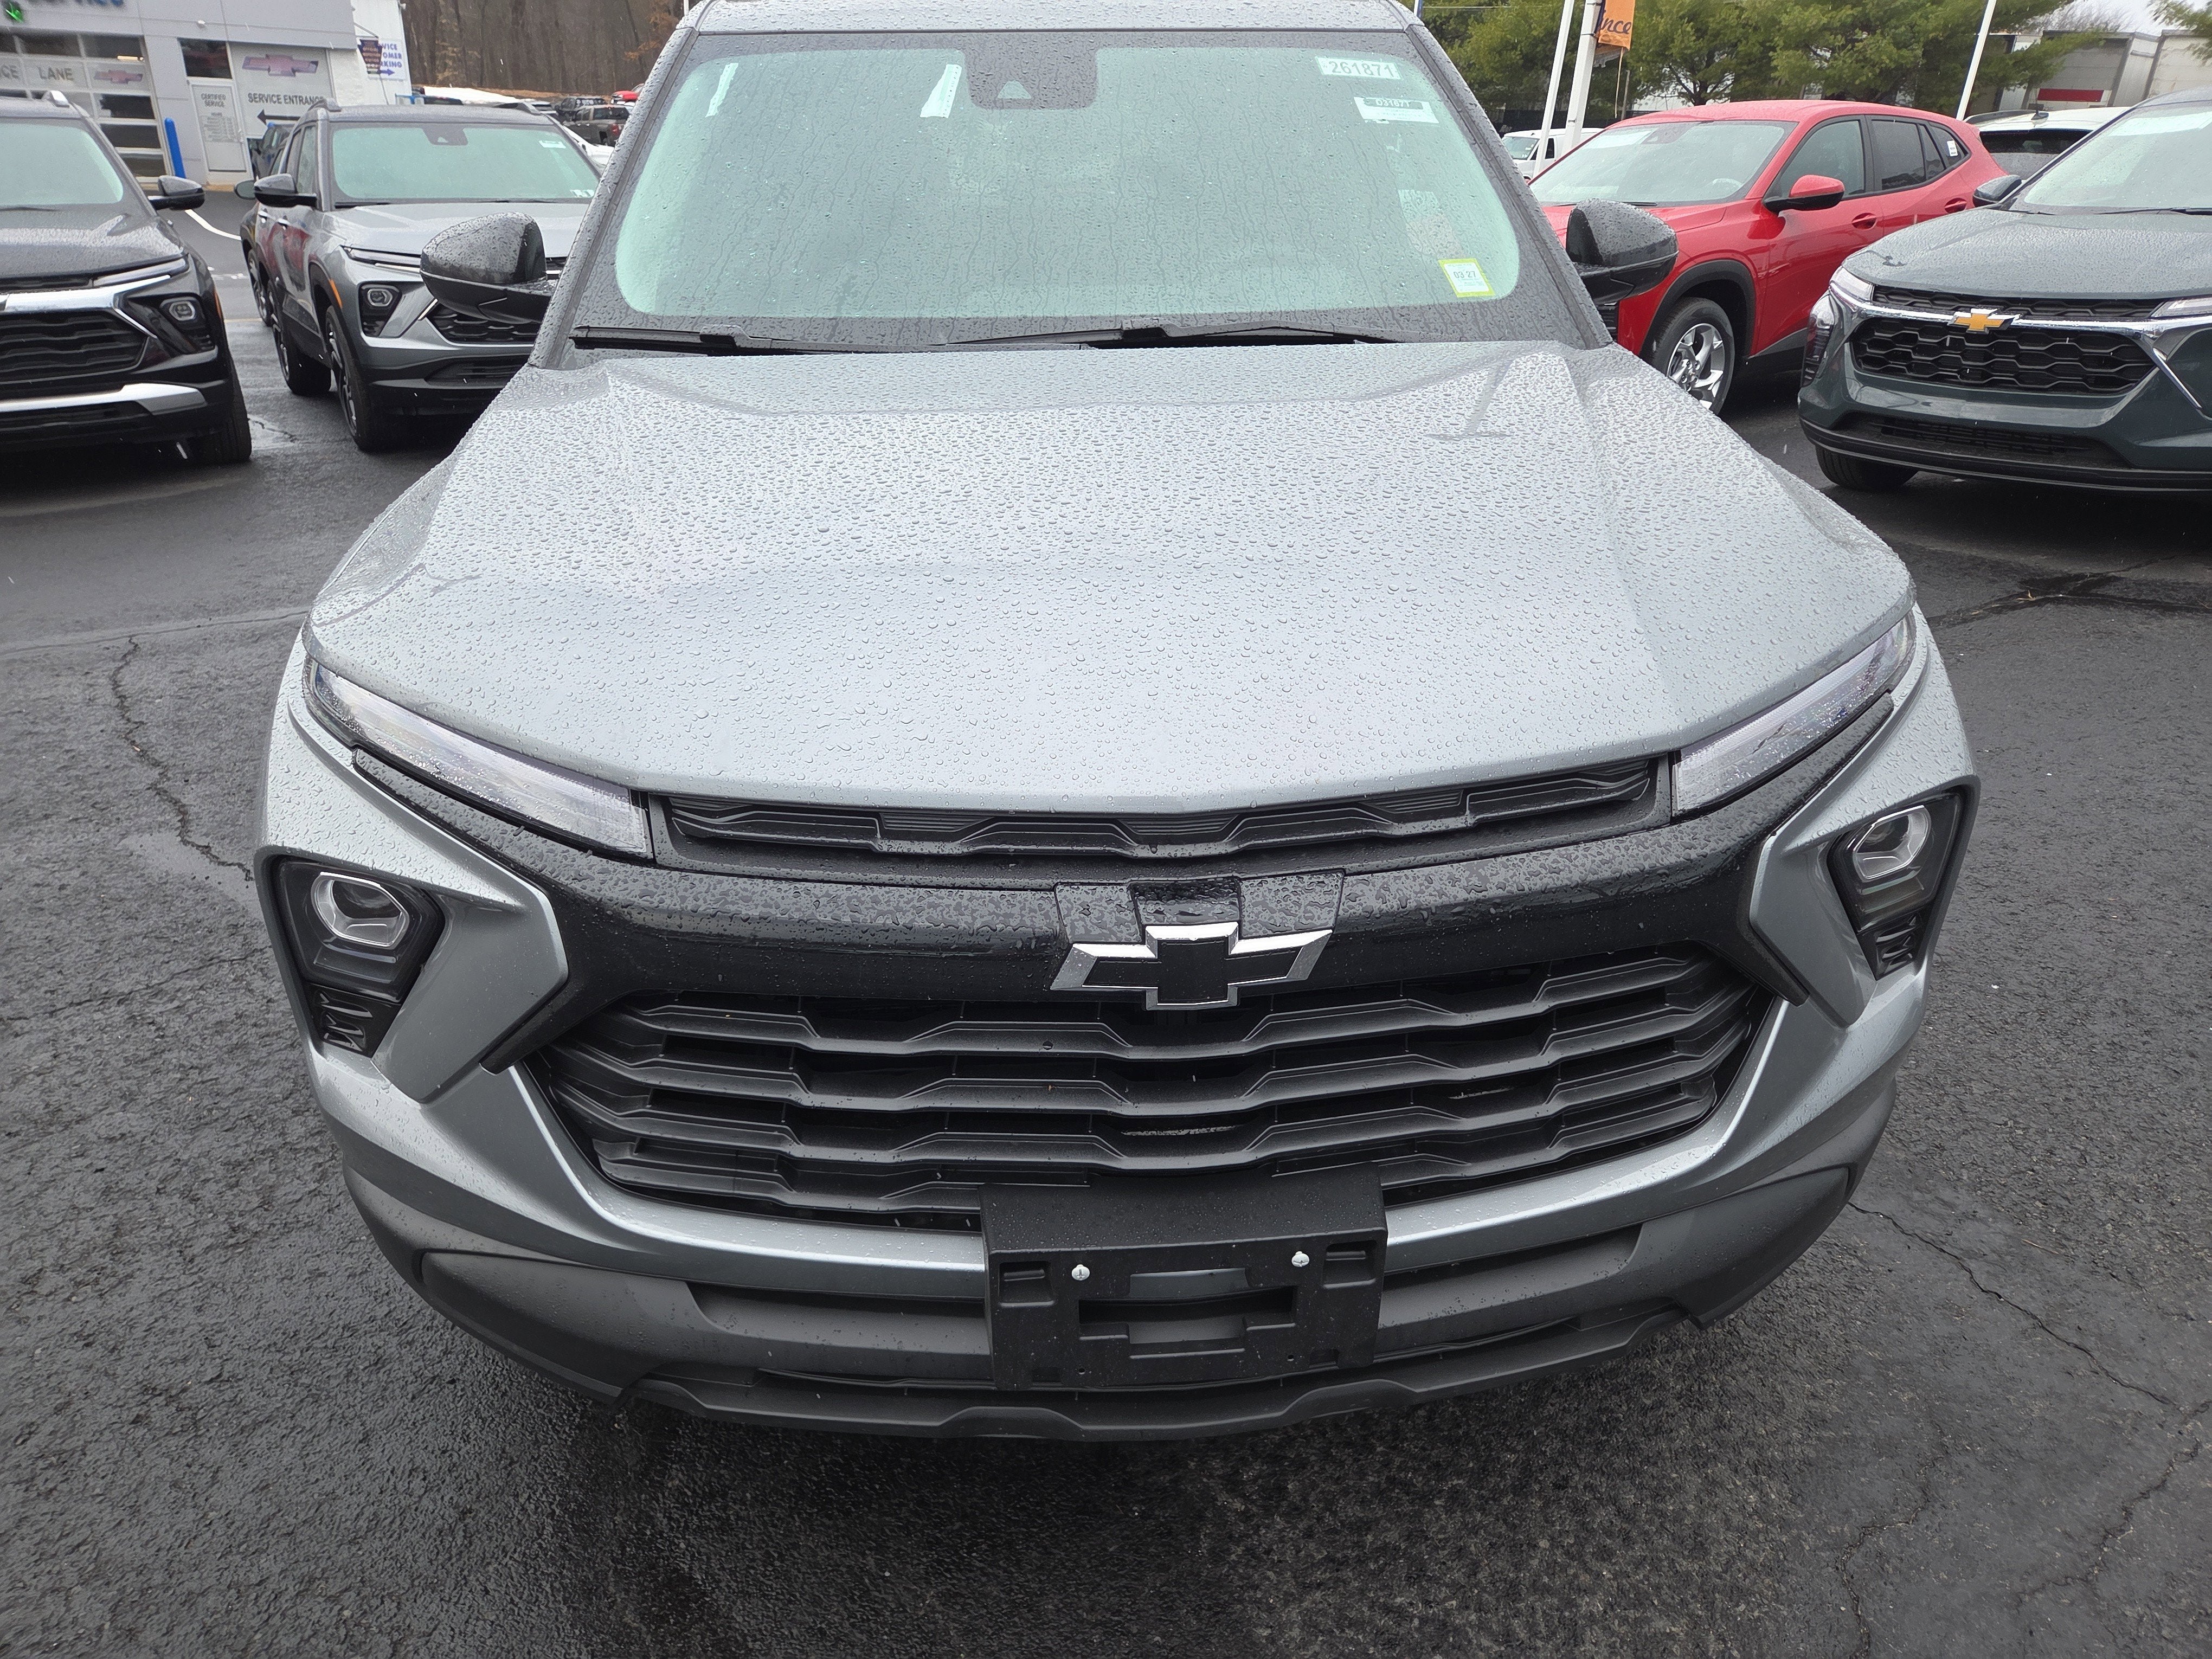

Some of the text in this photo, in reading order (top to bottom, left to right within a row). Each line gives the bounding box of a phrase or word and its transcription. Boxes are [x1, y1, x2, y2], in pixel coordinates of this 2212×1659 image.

[36, 66, 74, 81] LANE
[1329, 61, 1394, 78] 261871
[247, 92, 282, 105] SERVICE
